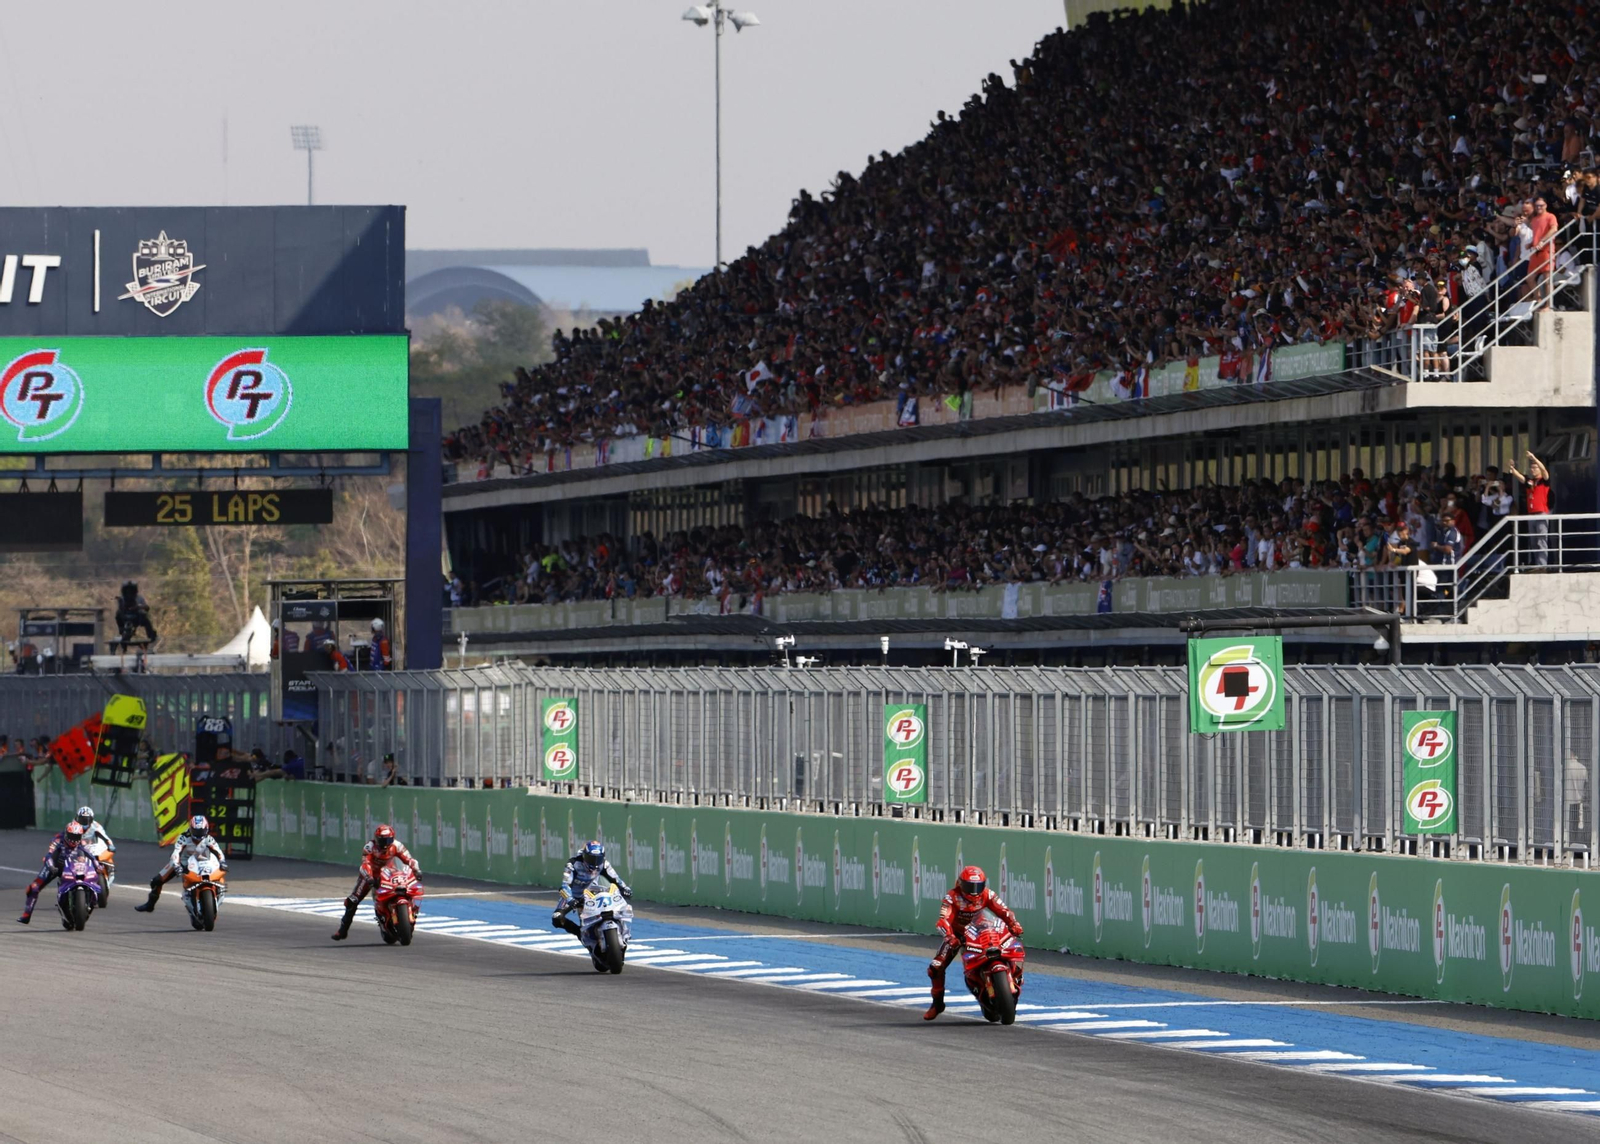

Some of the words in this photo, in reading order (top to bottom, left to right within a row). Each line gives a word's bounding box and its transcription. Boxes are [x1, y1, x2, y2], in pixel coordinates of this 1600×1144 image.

[138, 257, 189, 278] BURIRAM
[17, 371, 64, 420] PT
[226, 370, 273, 419] PT
[156, 494, 192, 523] 25
[212, 494, 280, 522] LAPS
[553, 710, 570, 728] PT
[896, 719, 916, 741] PT
[1418, 730, 1445, 757] PT
[553, 751, 570, 769] PT
[896, 768, 916, 789] PT
[1418, 791, 1443, 818] PT
[1503, 909, 1511, 968] PT
[1515, 918, 1556, 967] Maxnitron
[1573, 915, 1582, 976] PT
